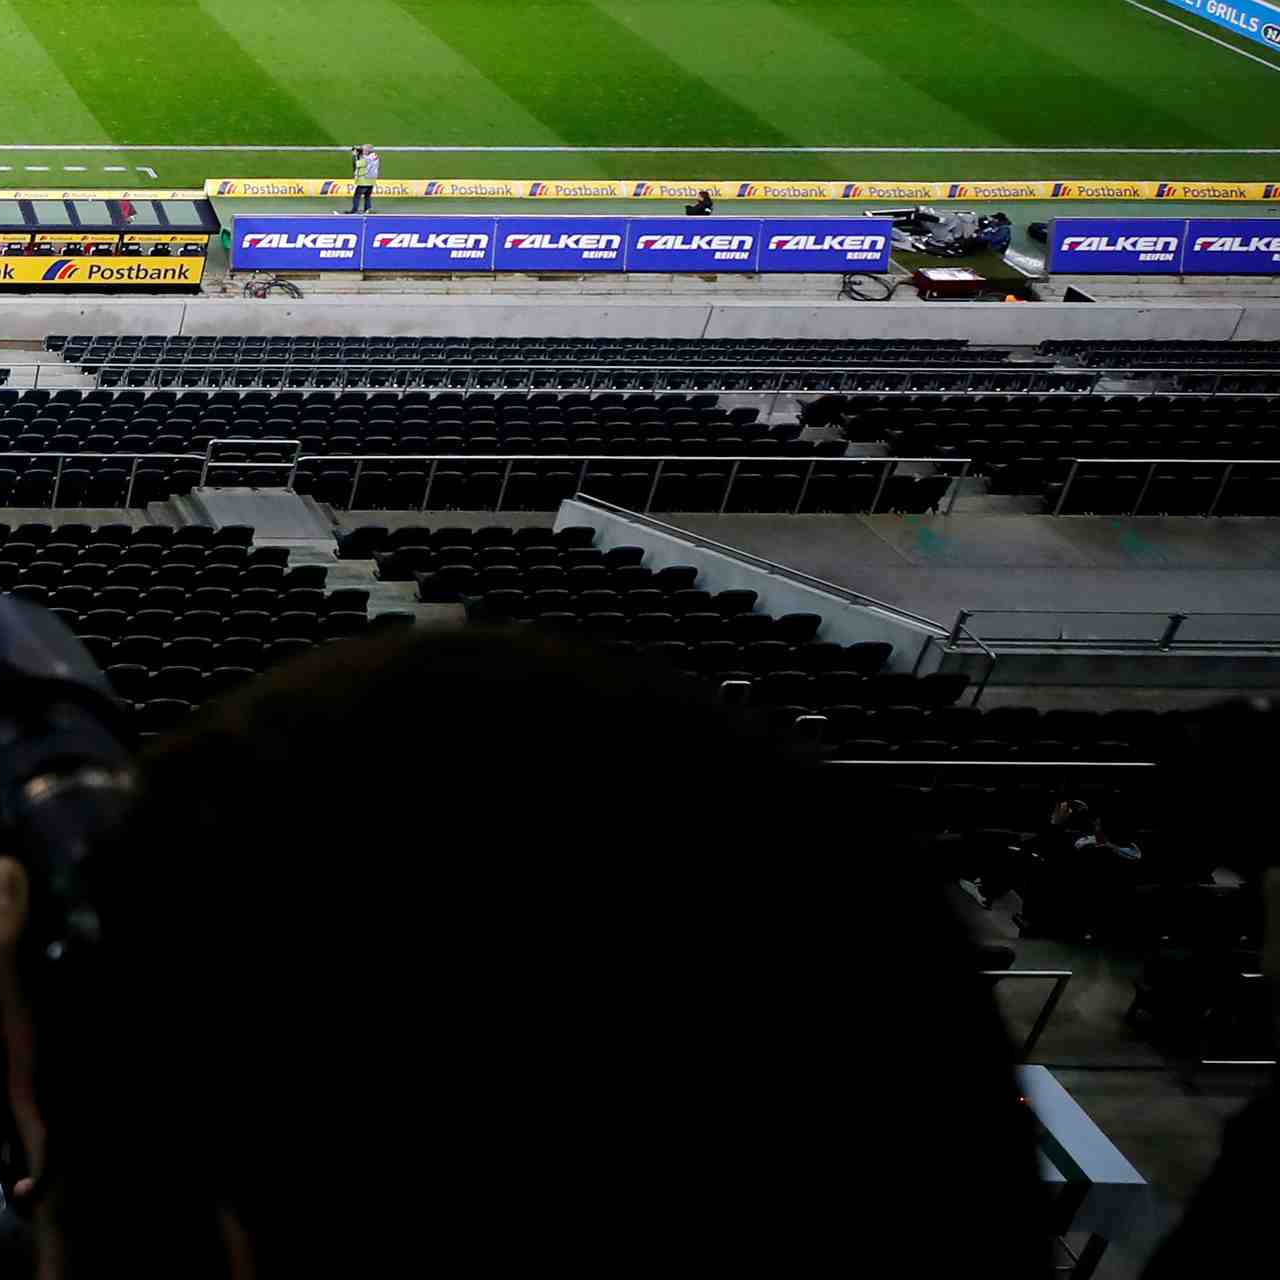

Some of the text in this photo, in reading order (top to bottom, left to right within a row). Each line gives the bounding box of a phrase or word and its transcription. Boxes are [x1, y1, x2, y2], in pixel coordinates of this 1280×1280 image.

[1206, 0, 1260, 33] GRILLS
[243, 182, 305, 197] Postbank
[450, 182, 514, 198] Postbank
[1077, 184, 1141, 200] Postbank
[1183, 184, 1248, 200] Postbank
[241, 233, 358, 250] FALKEN
[373, 233, 489, 250] FALKEN
[636, 234, 754, 251] FALKEN
[1061, 236, 1179, 252] FALKEN
[319, 249, 355, 259] REIFEN
[582, 250, 618, 260] REIFEN
[1139, 252, 1175, 262] REIFEN
[87, 264, 191, 283] Postbank
